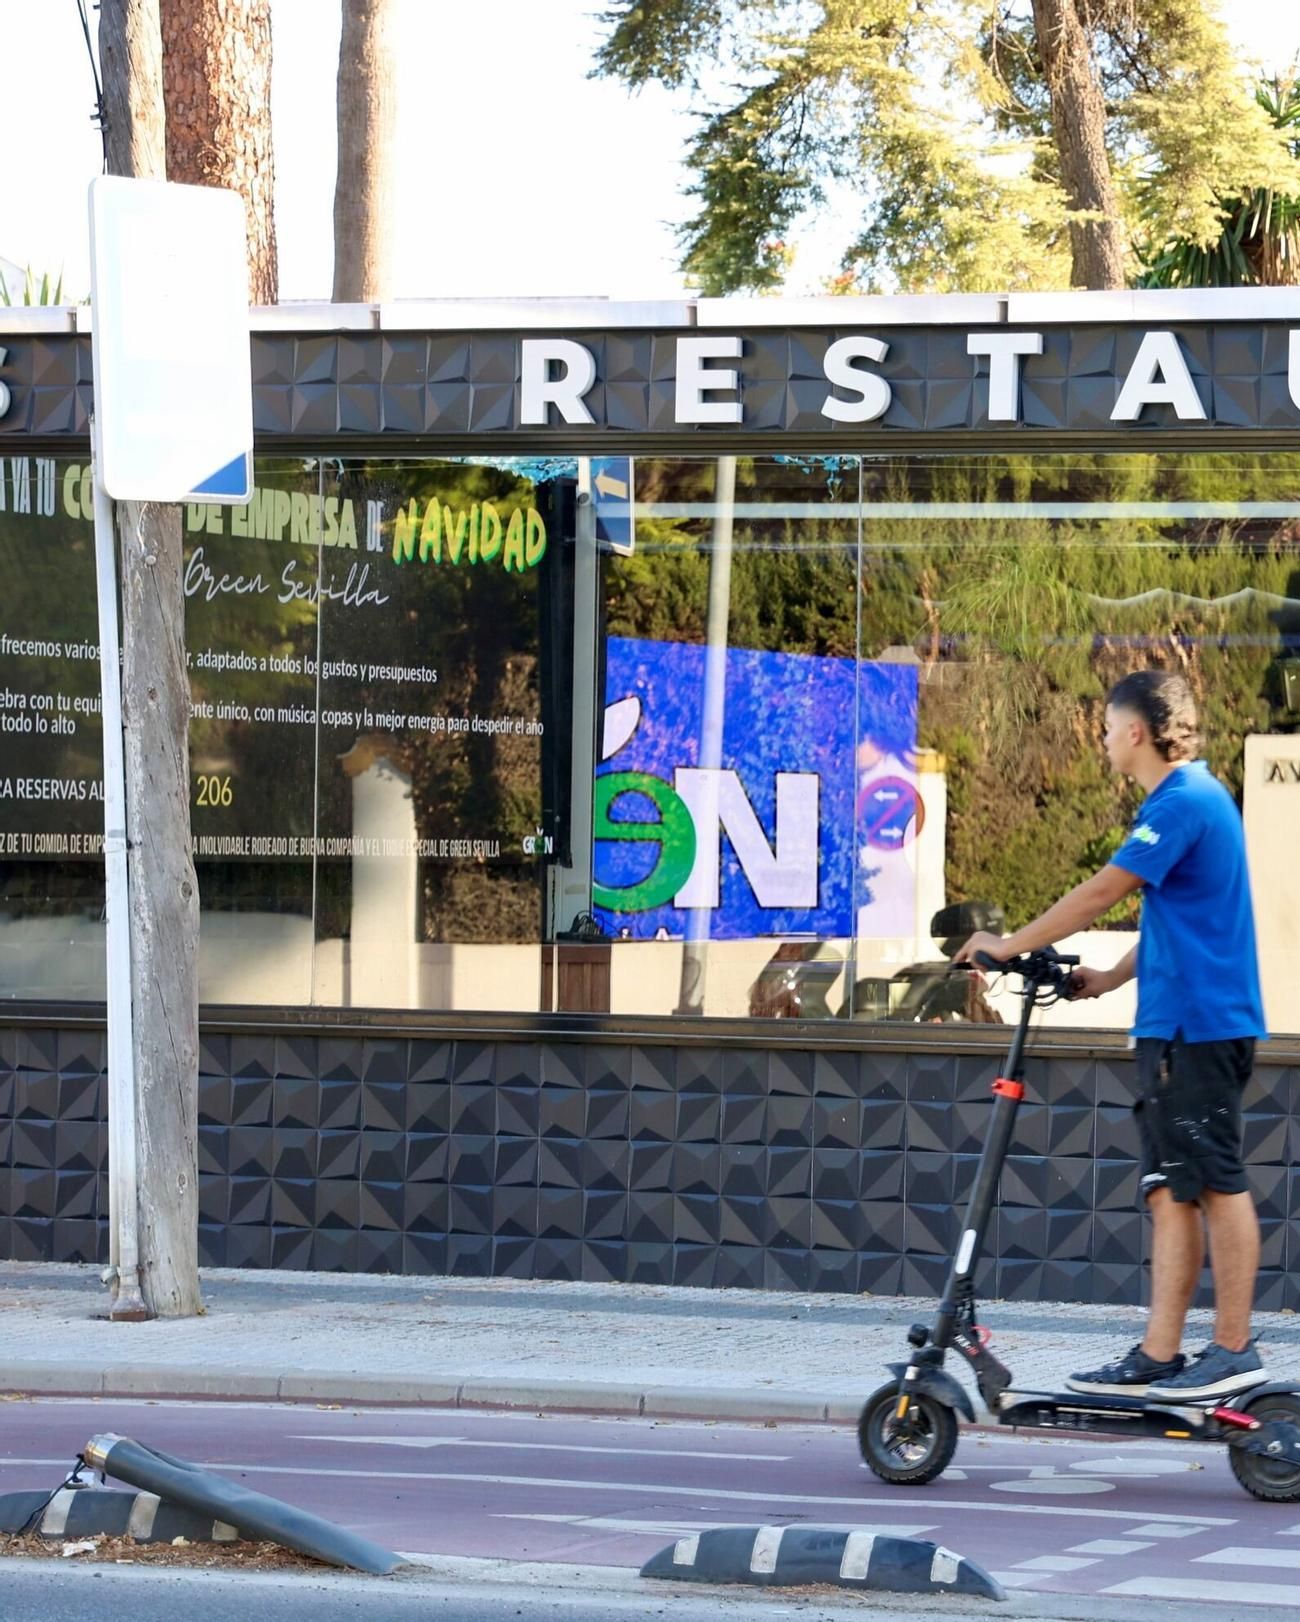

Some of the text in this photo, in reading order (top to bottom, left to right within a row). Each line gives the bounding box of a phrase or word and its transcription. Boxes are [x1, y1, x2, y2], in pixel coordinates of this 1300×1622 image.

[11, 456, 31, 514] YA
[36, 457, 56, 517] TU
[231, 487, 358, 549] EMPRESA
[367, 499, 384, 553] DE
[392, 496, 547, 573] NAVIDAD
[184, 547, 389, 607] Green Sevilla
[64, 639, 101, 660] varios
[196, 648, 257, 672] adaptados
[260, 657, 267, 671] a
[270, 655, 301, 673] todos
[304, 655, 319, 675] los
[322, 659, 357, 679] gustos
[360, 664, 367, 681] y
[368, 665, 437, 684] presupuestos
[2, 712, 76, 735] todo lo alto
[30, 694, 53, 710] con
[57, 692, 70, 711] tu
[74, 693, 101, 716] equi
[216, 700, 251, 724] único,
[254, 706, 274, 722] con
[321, 709, 353, 728] copas
[355, 711, 362, 730] y
[364, 708, 373, 726] la
[376, 709, 406, 732] mejor
[447, 717, 469, 734] para
[471, 714, 513, 736] despedir
[515, 717, 524, 735] el
[525, 717, 544, 736] año
[16, 778, 86, 800] RESERVAS
[88, 780, 105, 801] AL
[196, 776, 233, 806] 206
[7, 833, 19, 853] DE
[21, 834, 32, 853] TU
[34, 834, 68, 854] COMIDA
[70, 834, 81, 854] DE
[200, 836, 250, 856] INOLVIDABLE
[252, 836, 287, 856] RODEADO
[288, 837, 299, 856] DE
[300, 837, 324, 856] BUENA
[440, 838, 449, 857] DE
[450, 838, 473, 857] GREEN
[473, 838, 500, 858] SEVILLA
